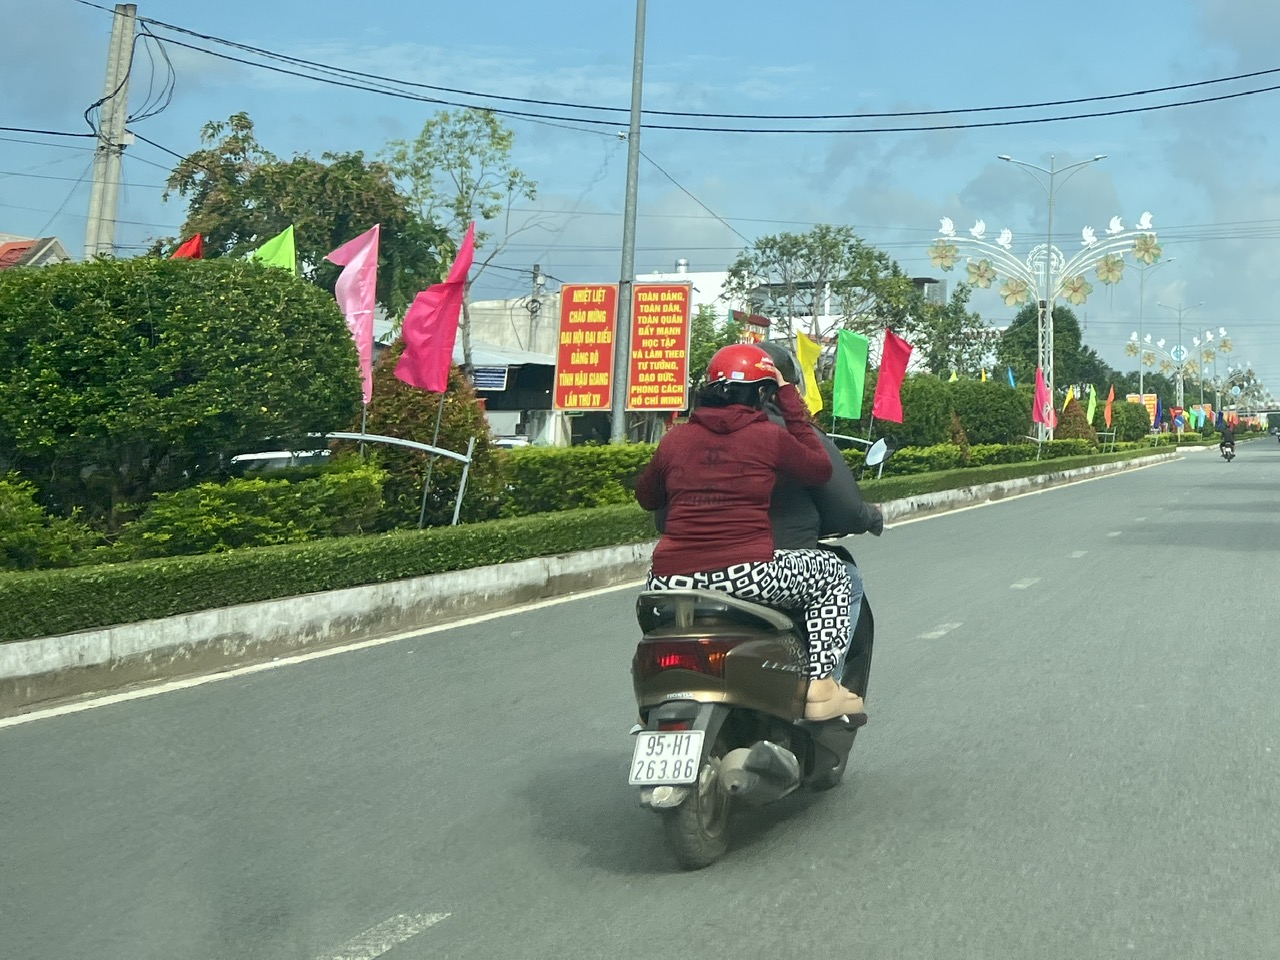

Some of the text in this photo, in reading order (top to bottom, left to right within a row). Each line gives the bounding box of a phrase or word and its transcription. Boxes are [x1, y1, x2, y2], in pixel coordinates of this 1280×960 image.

[573, 287, 606, 305] NHIỆT LIỆT
[638, 291, 659, 302] TOÀN
[640, 303, 661, 313] TOÀN
[569, 308, 587, 323] CHÀO
[637, 314, 683, 325] TOÀN QUÂN
[572, 328, 584, 346] HỘI
[642, 335, 676, 349] HỌC TẬP
[589, 349, 599, 367] BỘ
[632, 349, 685, 359] VÀ LÀM THEO
[574, 370, 588, 389] HẬU
[589, 372, 609, 386] GIANG
[631, 383, 684, 394] PHONG CÁCH
[565, 390, 578, 407] LẦN
[592, 393, 601, 407] XV
[631, 394, 683, 406] HỒ CHÍ MINH
